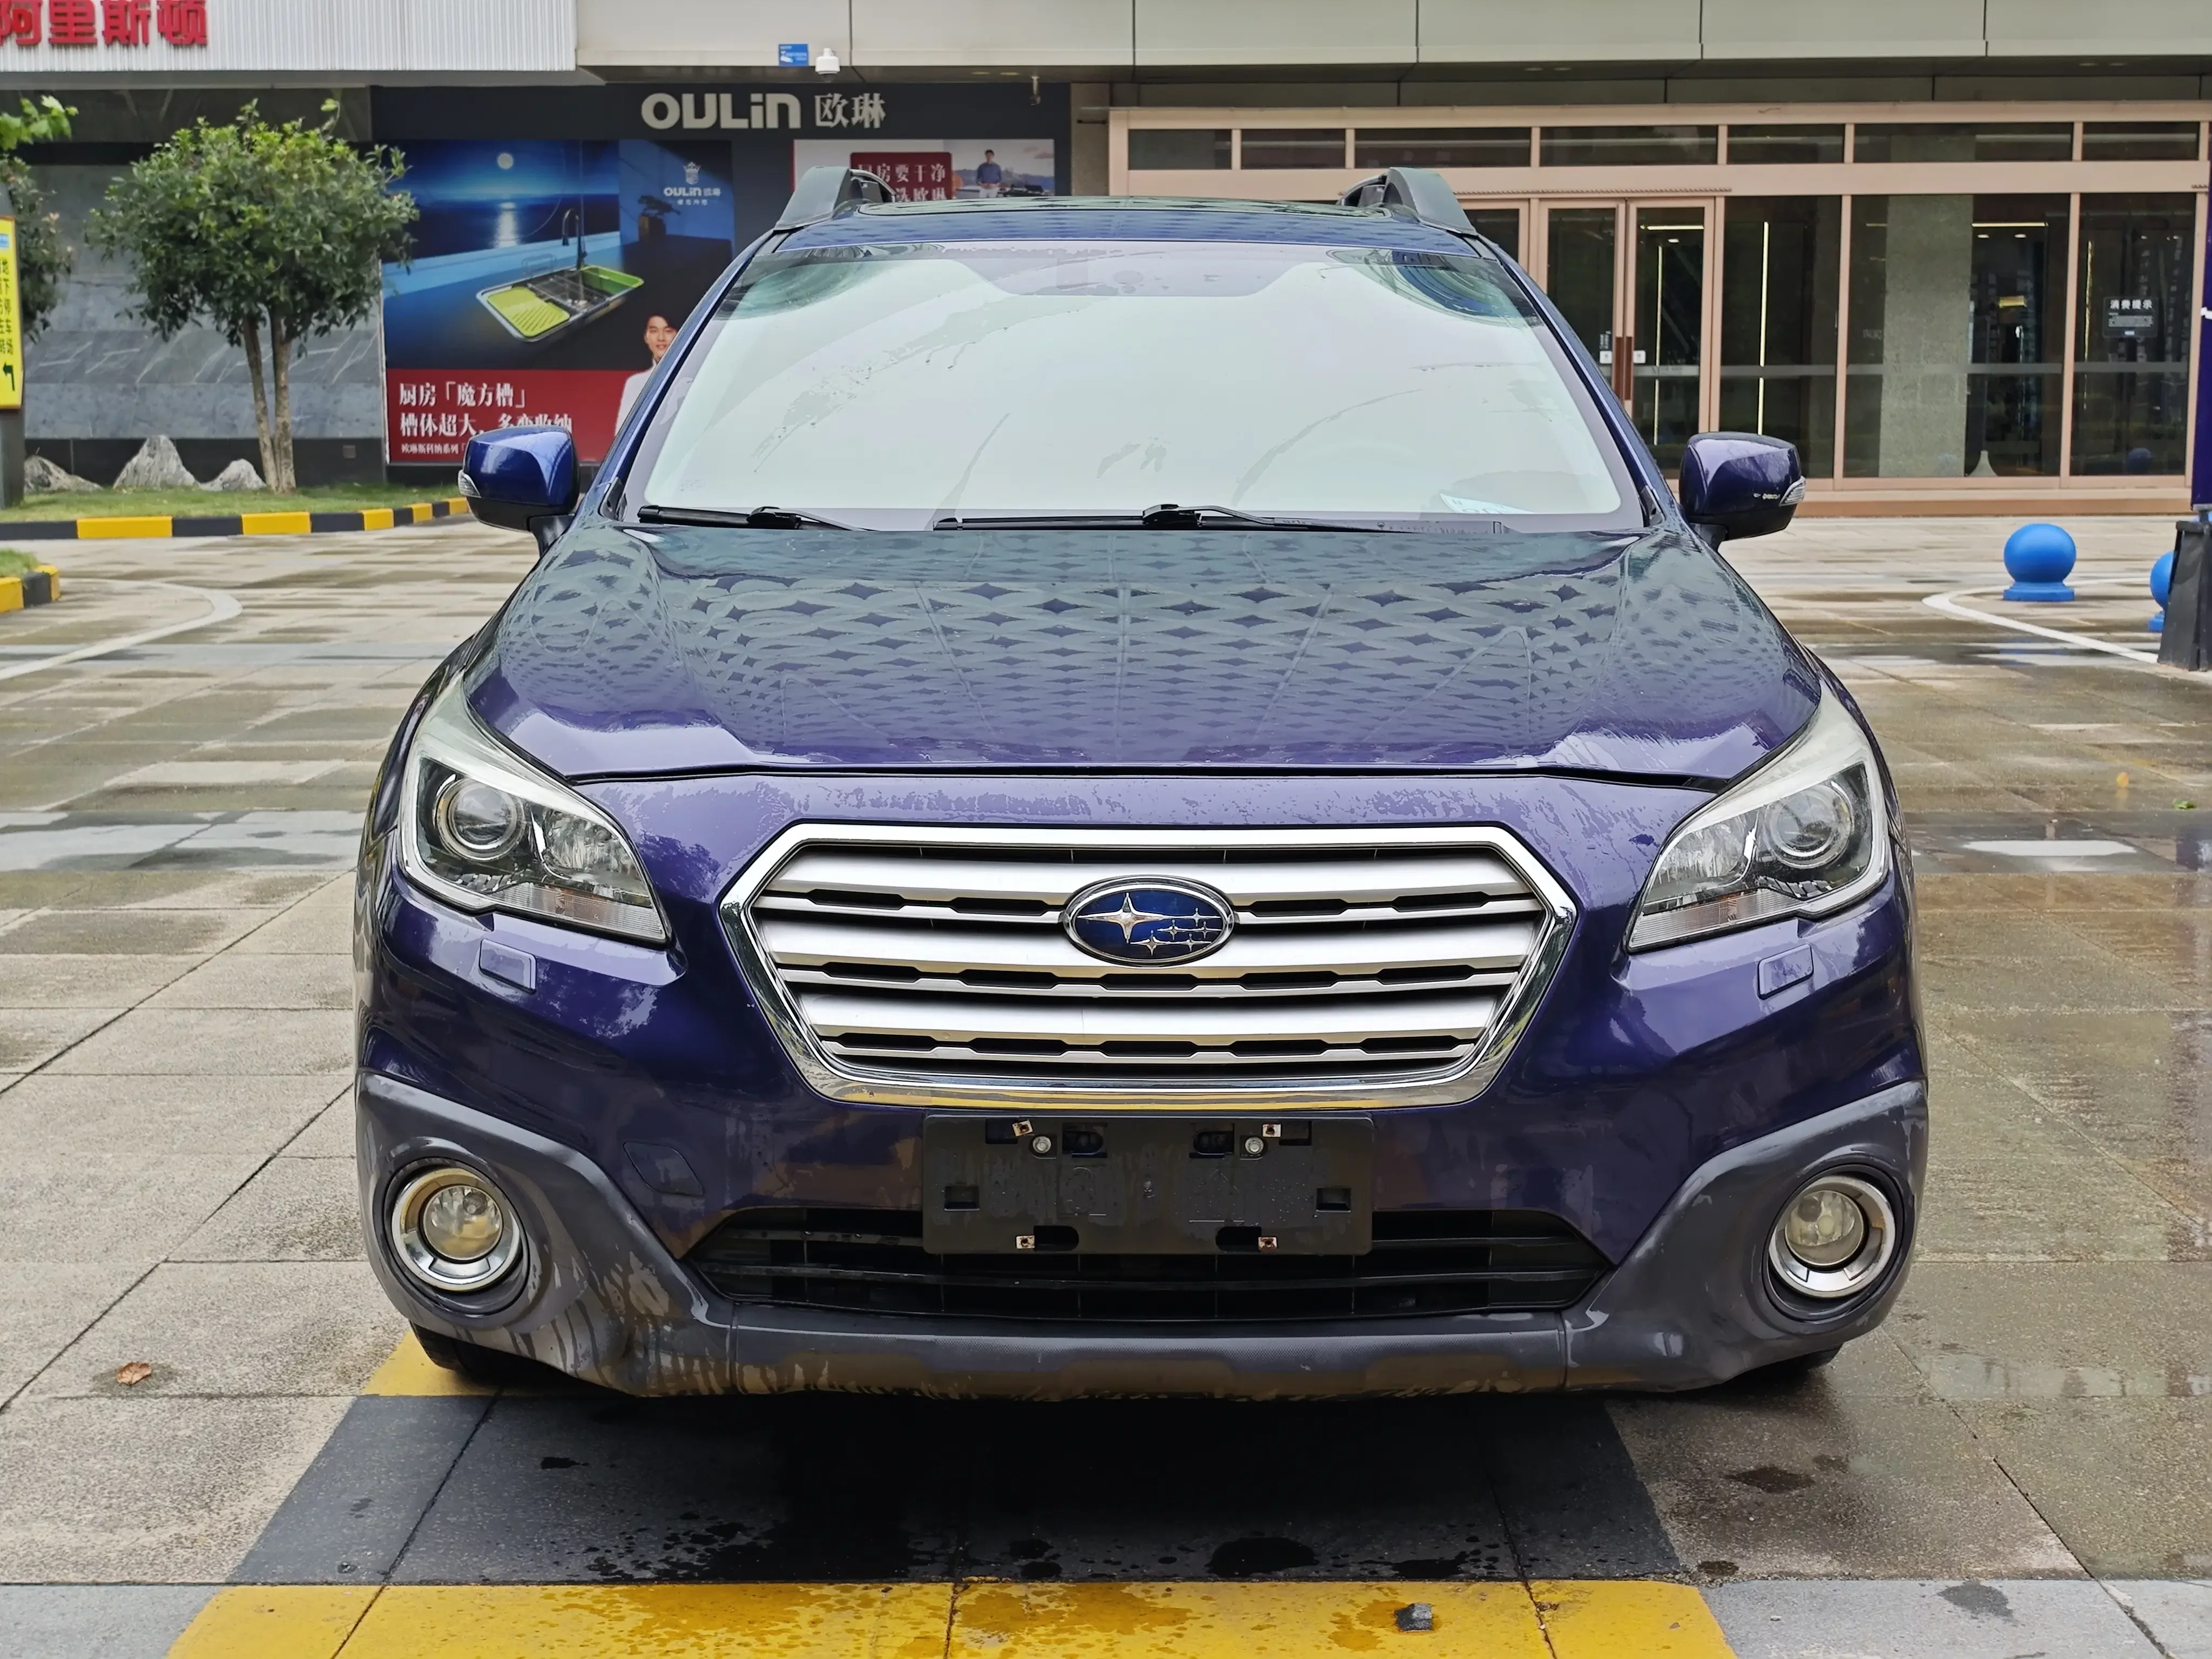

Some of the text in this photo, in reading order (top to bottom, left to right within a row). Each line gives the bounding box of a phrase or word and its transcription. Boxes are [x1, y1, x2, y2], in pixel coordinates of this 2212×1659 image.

[0, 0, 207, 45] 阿里斯顿
[814, 93, 886, 129] 欧琳
